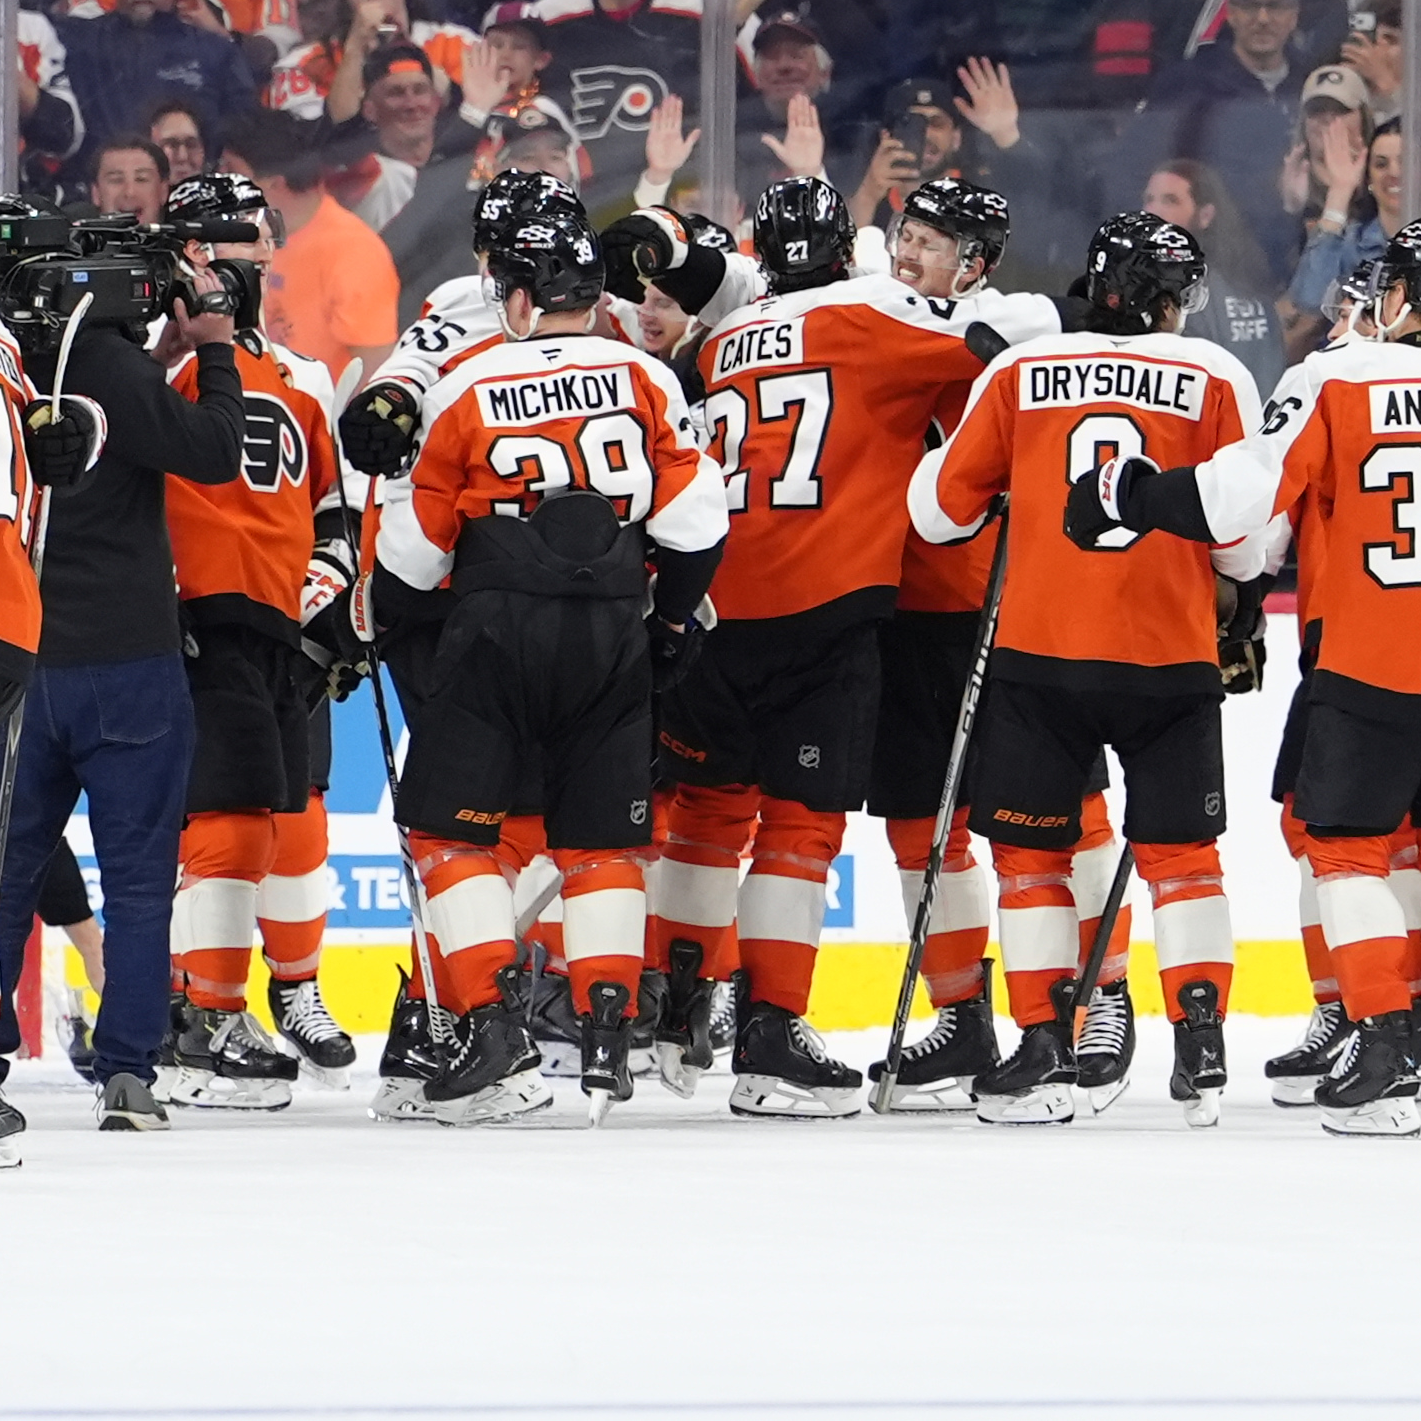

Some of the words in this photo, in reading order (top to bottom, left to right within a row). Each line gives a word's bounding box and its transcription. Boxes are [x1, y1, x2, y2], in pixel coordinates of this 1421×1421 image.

[480, 199, 504, 220] 55
[573, 240, 594, 265] 39
[785, 240, 808, 262] 27
[1095, 250, 1107, 272] 9
[720, 323, 793, 374] CATES
[488, 373, 619, 421] MICHKOV
[1030, 364, 1196, 412] DRYSDALE
[703, 367, 833, 511] 27
